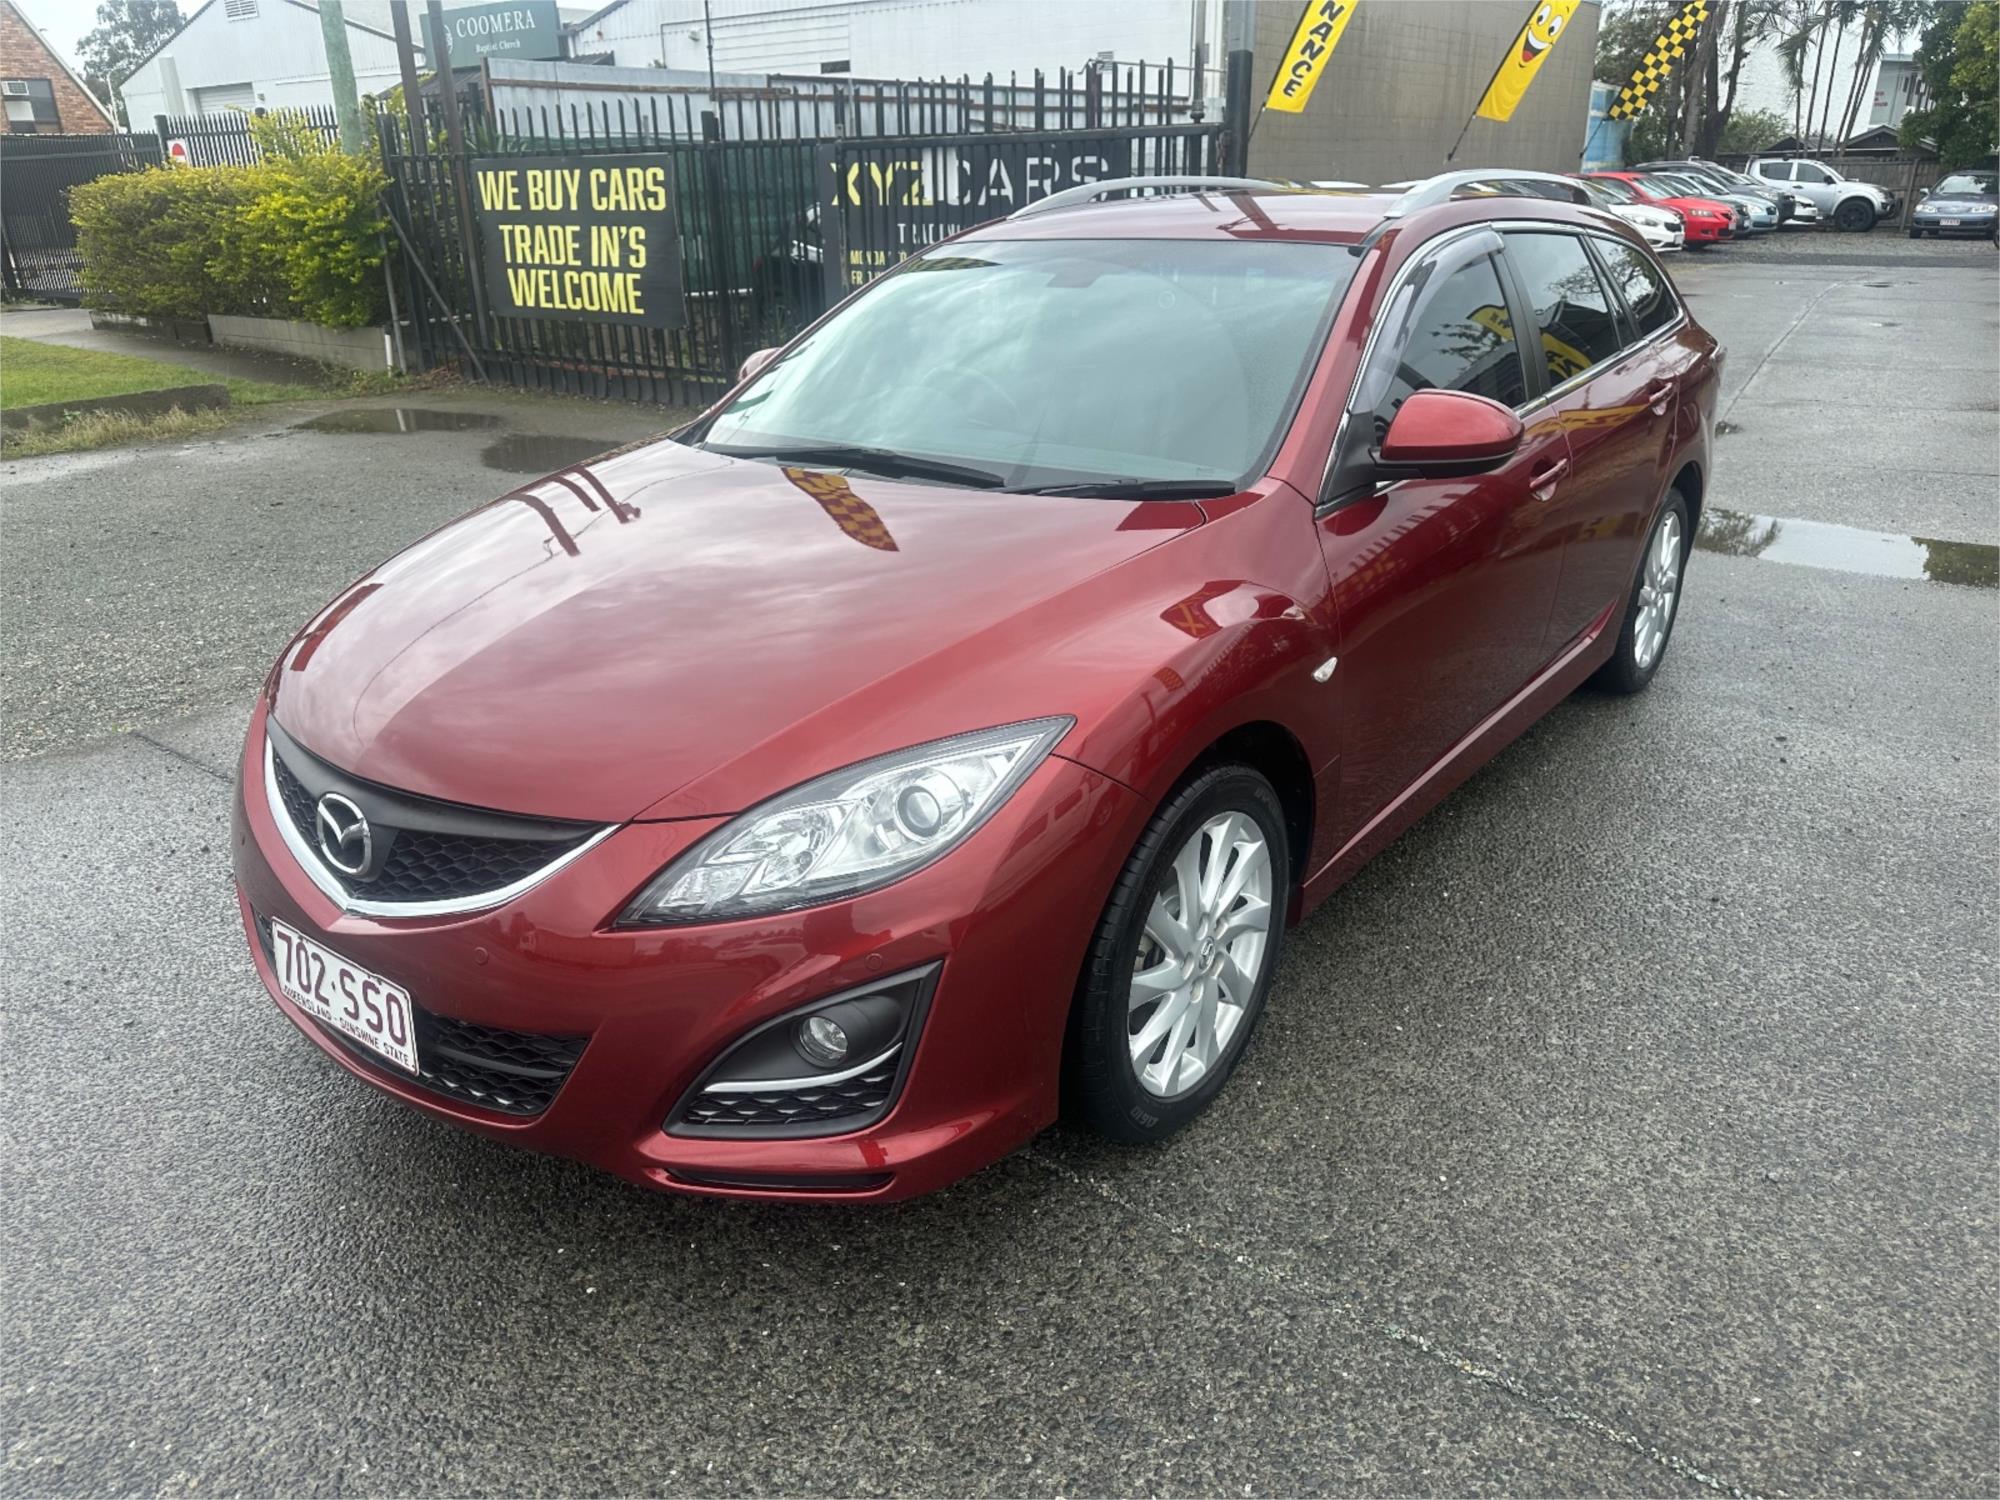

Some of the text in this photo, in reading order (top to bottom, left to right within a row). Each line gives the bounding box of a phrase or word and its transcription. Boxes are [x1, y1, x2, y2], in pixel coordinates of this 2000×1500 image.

[456, 9, 536, 38] COOMERA
[477, 167, 666, 211] WE BUY CARS
[499, 224, 646, 268] TRADE IN'S
[507, 268, 645, 315] WELCOME
[339, 1017, 380, 1049] SUNSHINE
[383, 1042, 410, 1067] STATE
